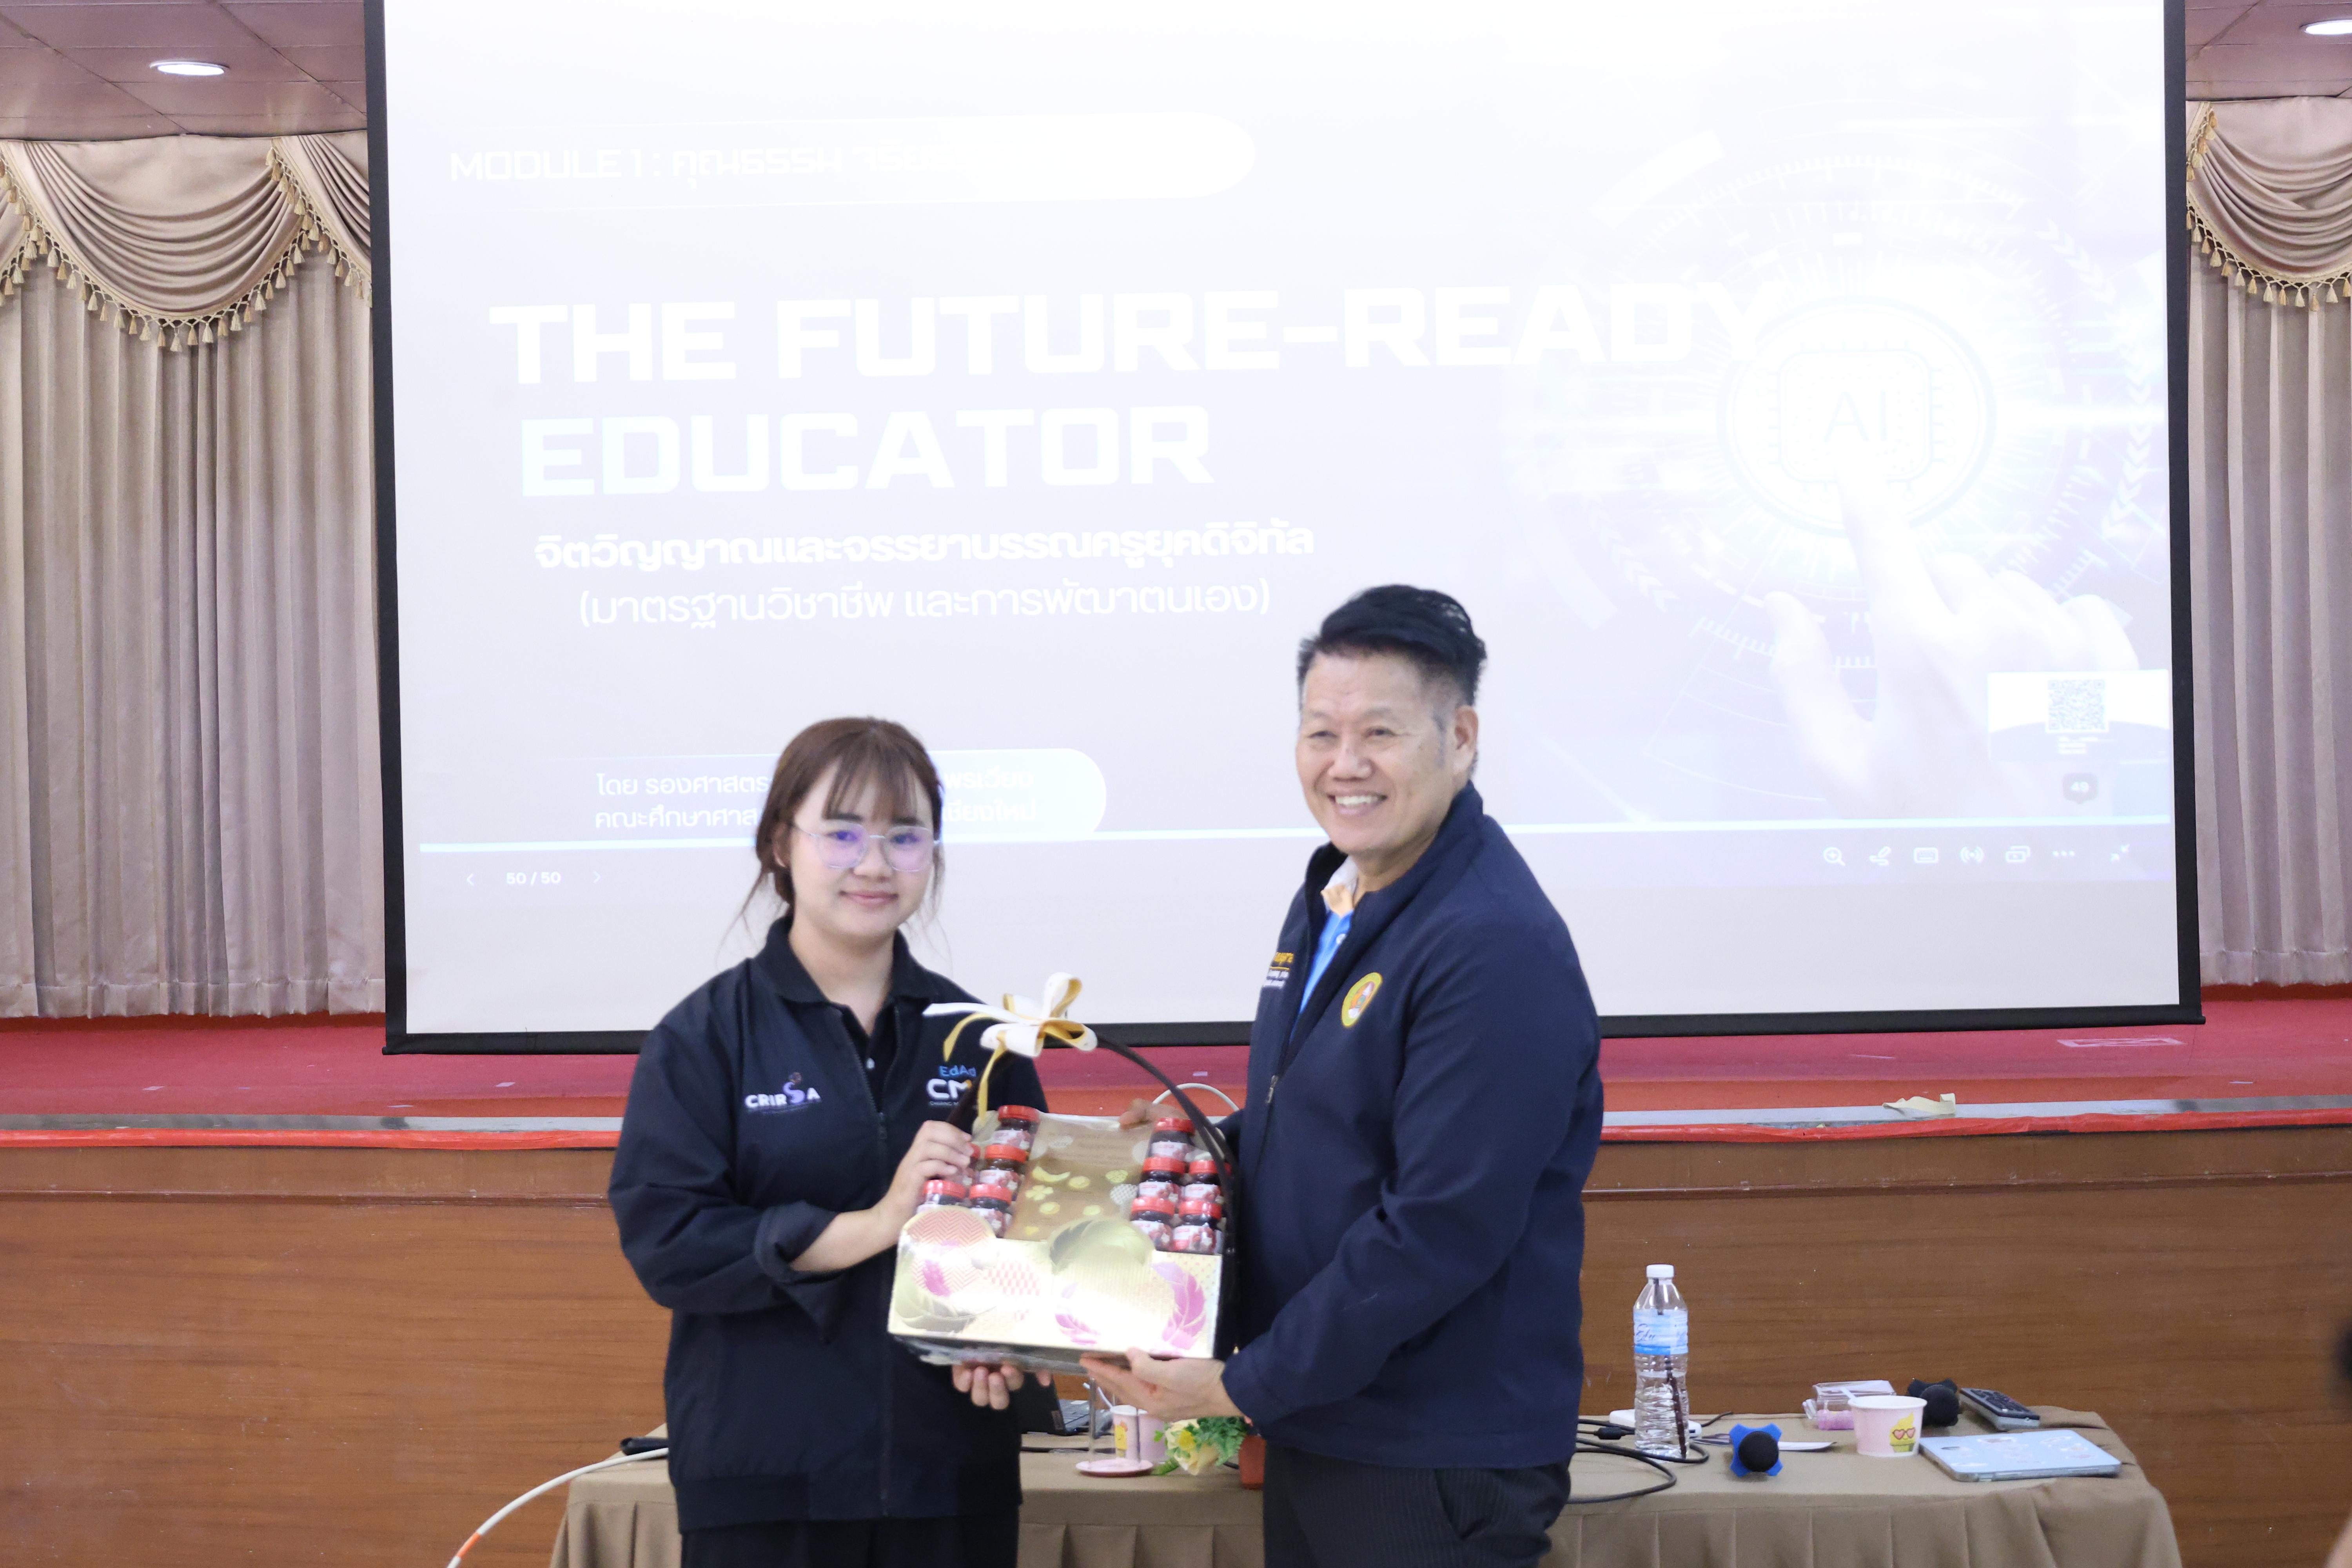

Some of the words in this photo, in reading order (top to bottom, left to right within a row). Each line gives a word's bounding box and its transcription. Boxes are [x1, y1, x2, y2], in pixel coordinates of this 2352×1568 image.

[450, 149, 622, 181] MODULE
[672, 147, 843, 189] คุณธรรม
[488, 301, 737, 385] THE
[777, 281, 1788, 378] FUTURE-READY
[1822, 390, 1887, 443] AI
[521, 405, 1216, 497] EDUCATOR
[595, 771, 639, 796] โดย
[645, 773, 769, 795] รองศาสตร
[595, 803, 758, 829] คณะศึกษาศาส
[926, 1078, 973, 1100] CM
